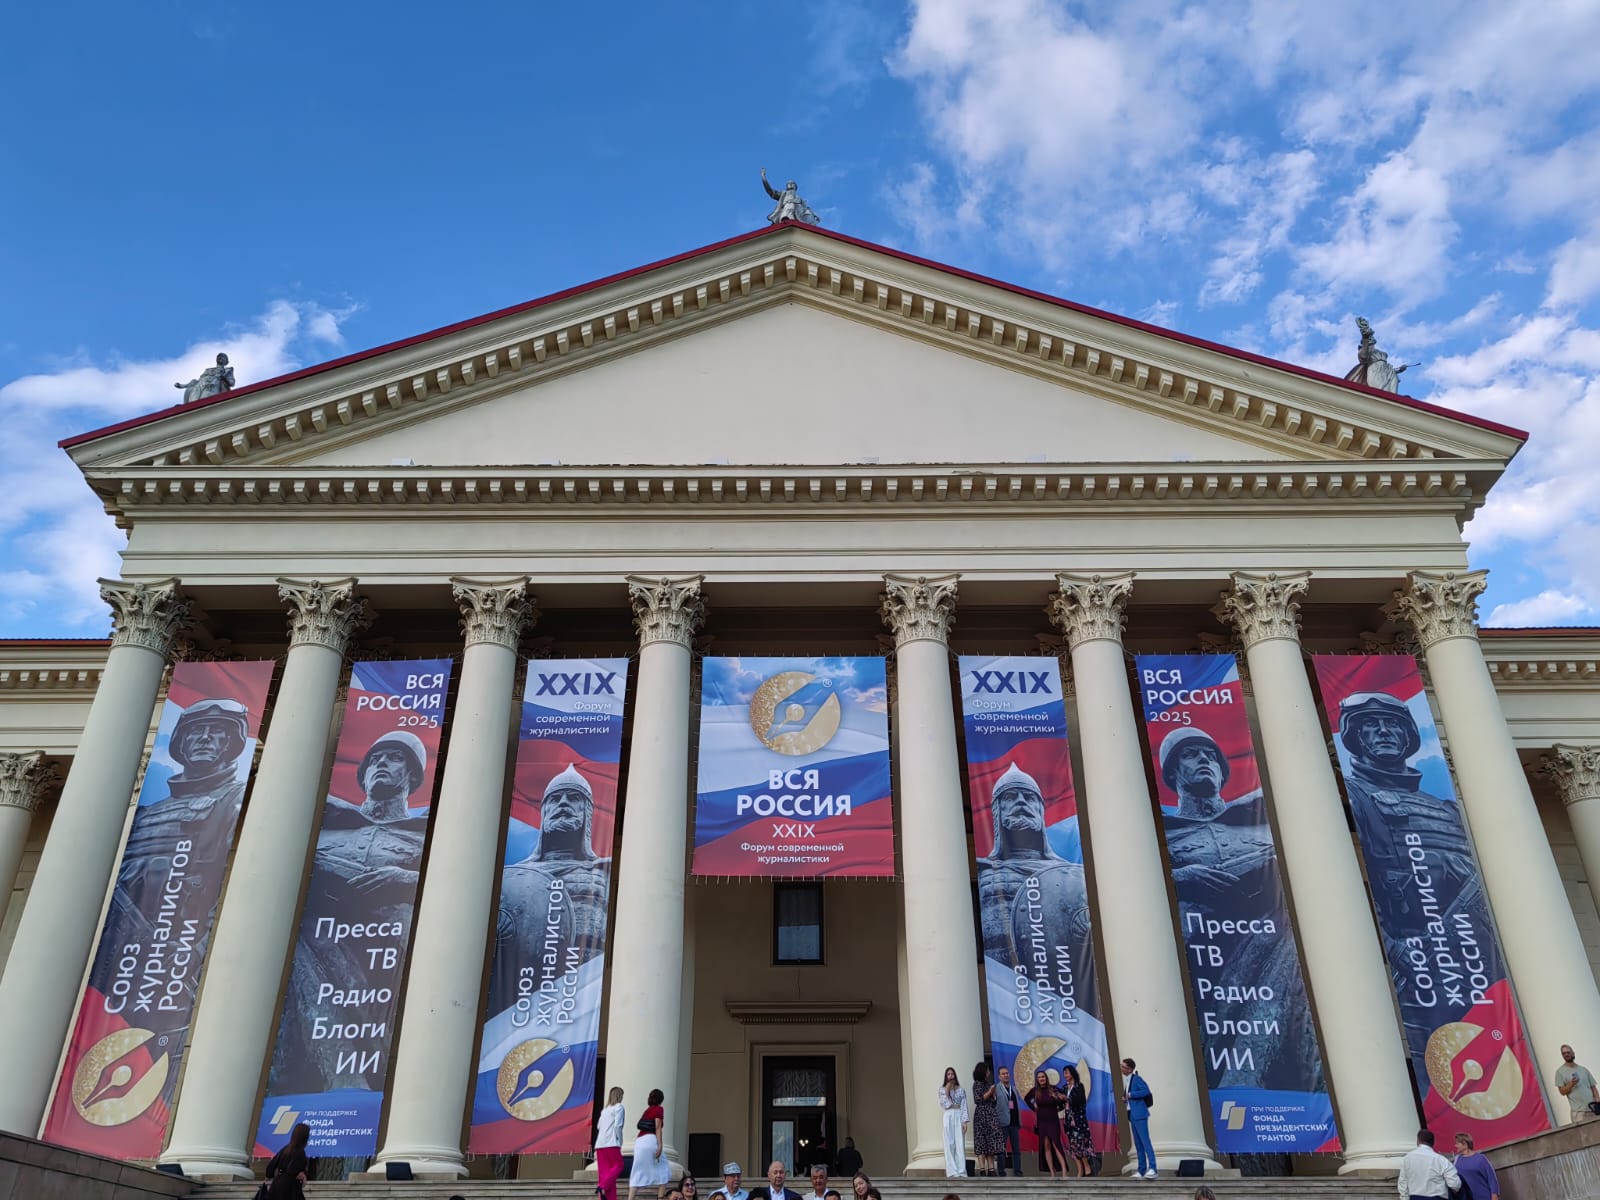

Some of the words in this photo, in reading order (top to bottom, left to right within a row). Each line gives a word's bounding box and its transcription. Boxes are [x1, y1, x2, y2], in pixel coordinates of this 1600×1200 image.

[406, 673, 445, 690] ВСЯ
[535, 672, 617, 695] XXIX
[970, 671, 1053, 693] XXIX
[1143, 669, 1183, 685] ВСЯ
[356, 693, 442, 712] РОССИЯ
[573, 701, 612, 712] Форум
[972, 699, 1011, 710] Форум
[1146, 689, 1233, 705] РОССИЯ
[397, 715, 439, 729] 2025
[973, 711, 1049, 722] современной
[1149, 711, 1192, 726] 2025
[529, 726, 610, 737] журналистики
[974, 724, 1055, 735] журналистики
[769, 769, 819, 790] ВСЯ
[736, 794, 851, 817] РОССИЯ
[772, 823, 816, 839] XXIX
[741, 842, 775, 852] Форум
[777, 841, 844, 852] современной
[757, 855, 830, 865] журналистики
[134, 839, 192, 1012] журналистов
[315, 917, 403, 943] Пресса
[1186, 912, 1277, 939] Пресса
[1405, 832, 1466, 1007] журналистов
[366, 948, 398, 970] ТВ
[537, 879, 564, 1026] журналистов
[1026, 876, 1057, 1025] журналистов
[1189, 944, 1224, 967] ТВ
[1453, 913, 1494, 1006] России
[158, 919, 198, 1011] России
[1406, 936, 1437, 1008] Союз
[104, 943, 141, 1013] Союз
[557, 947, 580, 1024] России
[1056, 945, 1078, 1023] России
[317, 983, 392, 1007] Радио
[512, 966, 534, 1027] Союз
[1015, 964, 1033, 1025] Союз
[1197, 978, 1274, 1003] Радио
[311, 1017, 386, 1039] Блоги
[1204, 1012, 1280, 1035] Блоги
[335, 1050, 380, 1074] ИИ
[1210, 1047, 1255, 1071] ИИ
[1253, 1115, 1285, 1123] ФОНДА
[1255, 1123, 1328, 1133] ПРЕЗИДЕНТСКИХ
[1257, 1134, 1296, 1142] ГРАНТОВ
